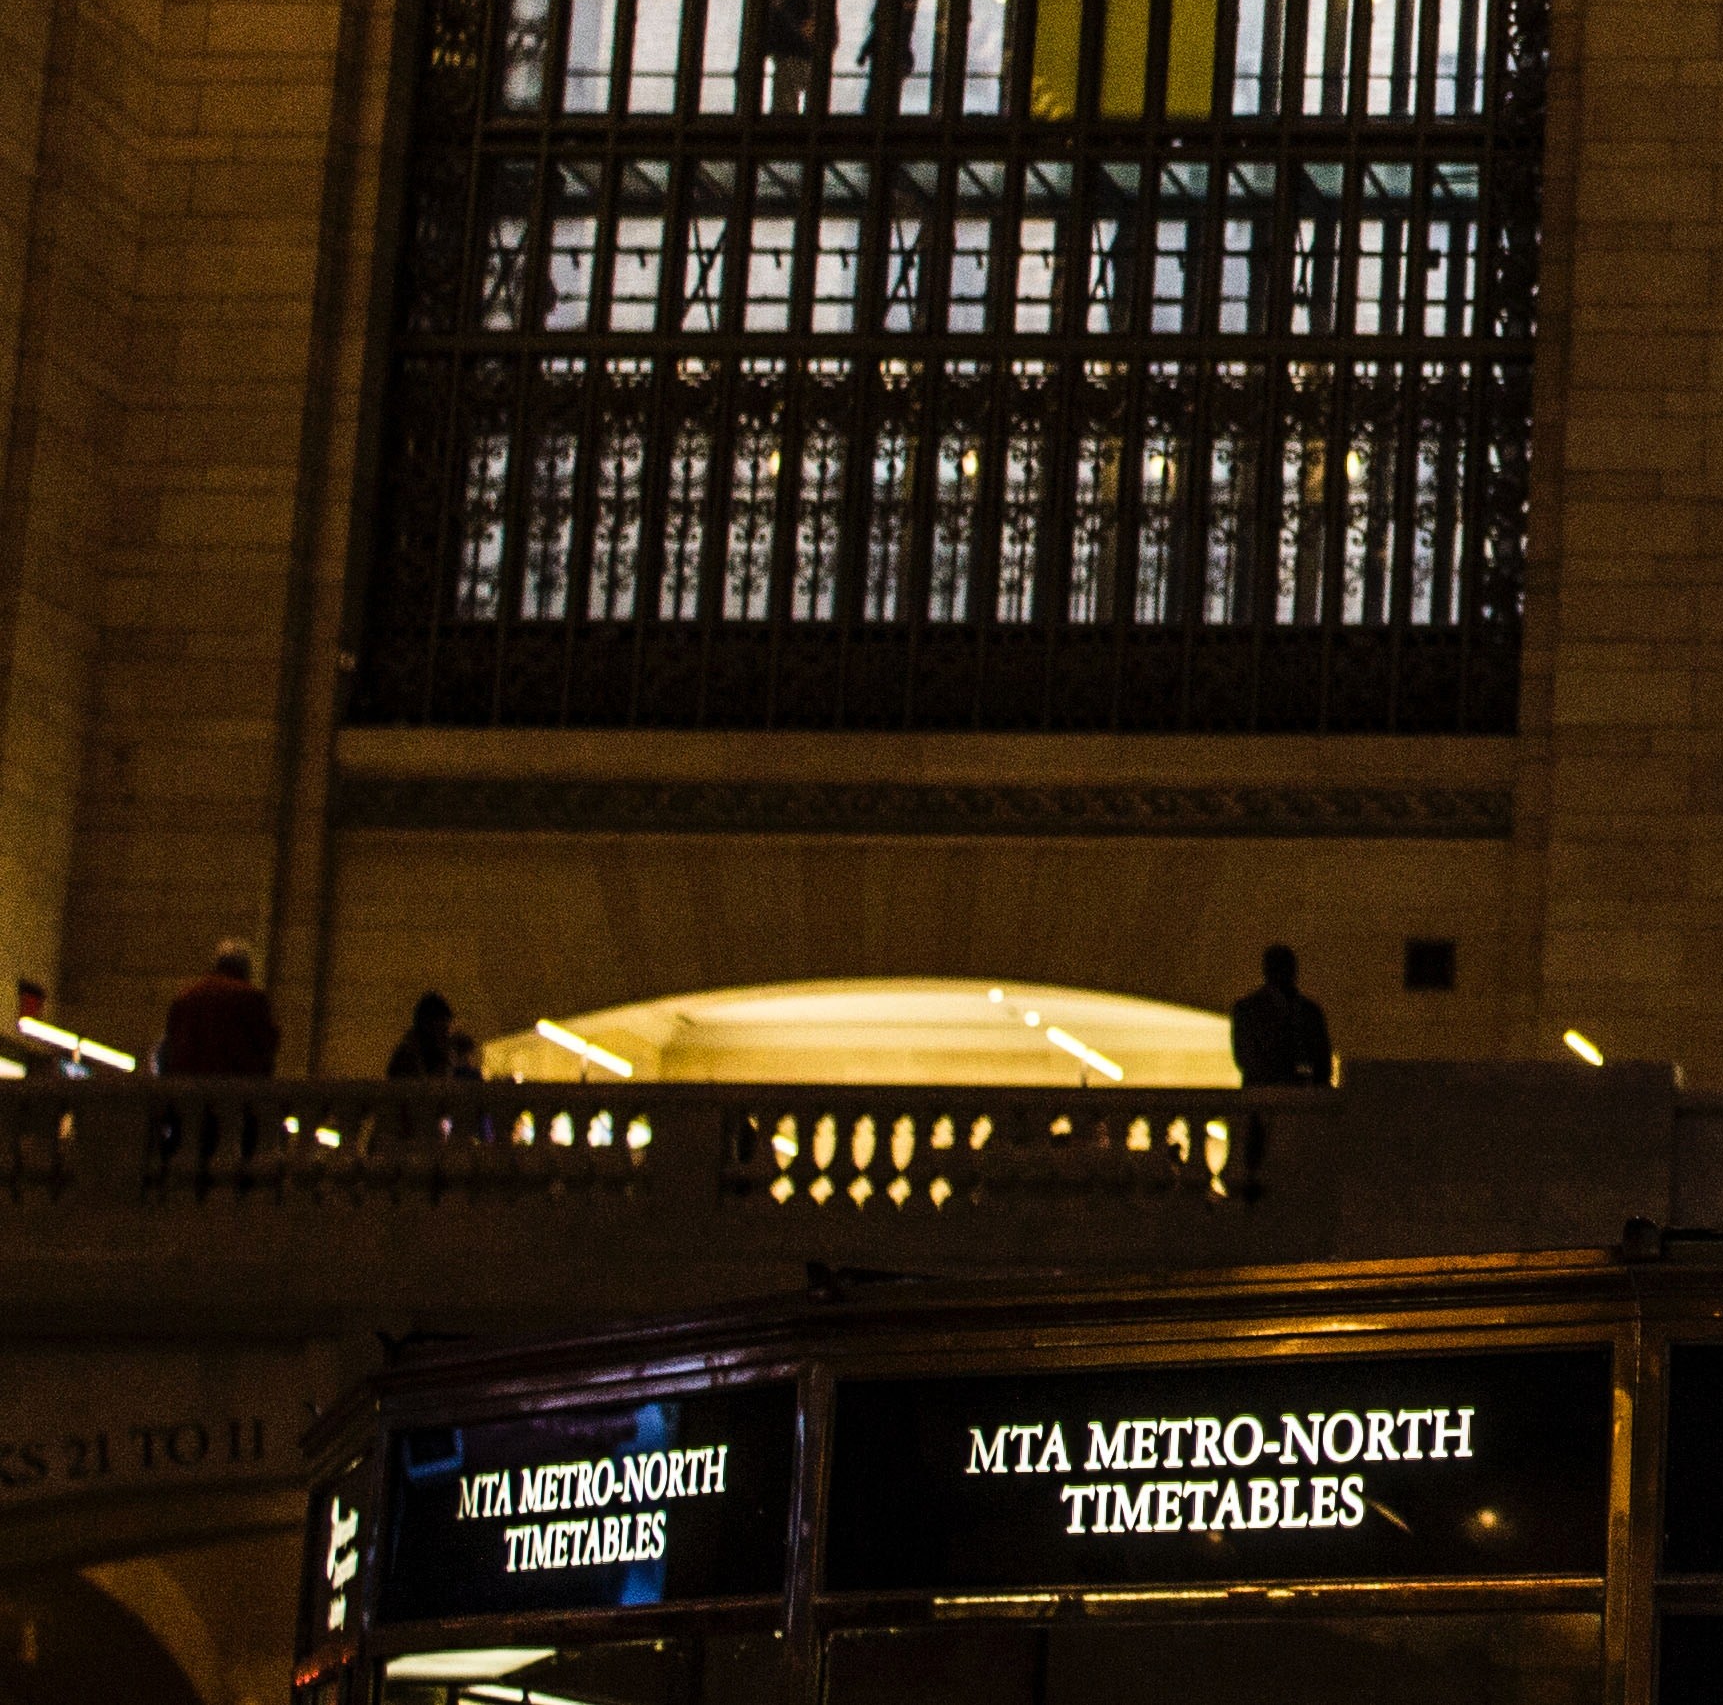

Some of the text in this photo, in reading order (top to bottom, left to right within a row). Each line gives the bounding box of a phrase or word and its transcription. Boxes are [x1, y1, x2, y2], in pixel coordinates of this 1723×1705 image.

[64, 1429, 109, 1478] 21
[128, 1420, 208, 1469] TO
[965, 1407, 1475, 1474] MTA METRO-NORTH
[457, 1444, 729, 1521] MTA METRO-NORTH
[1059, 1473, 1366, 1535] TIMETABLES
[503, 1509, 667, 1573] TIMETABLES
